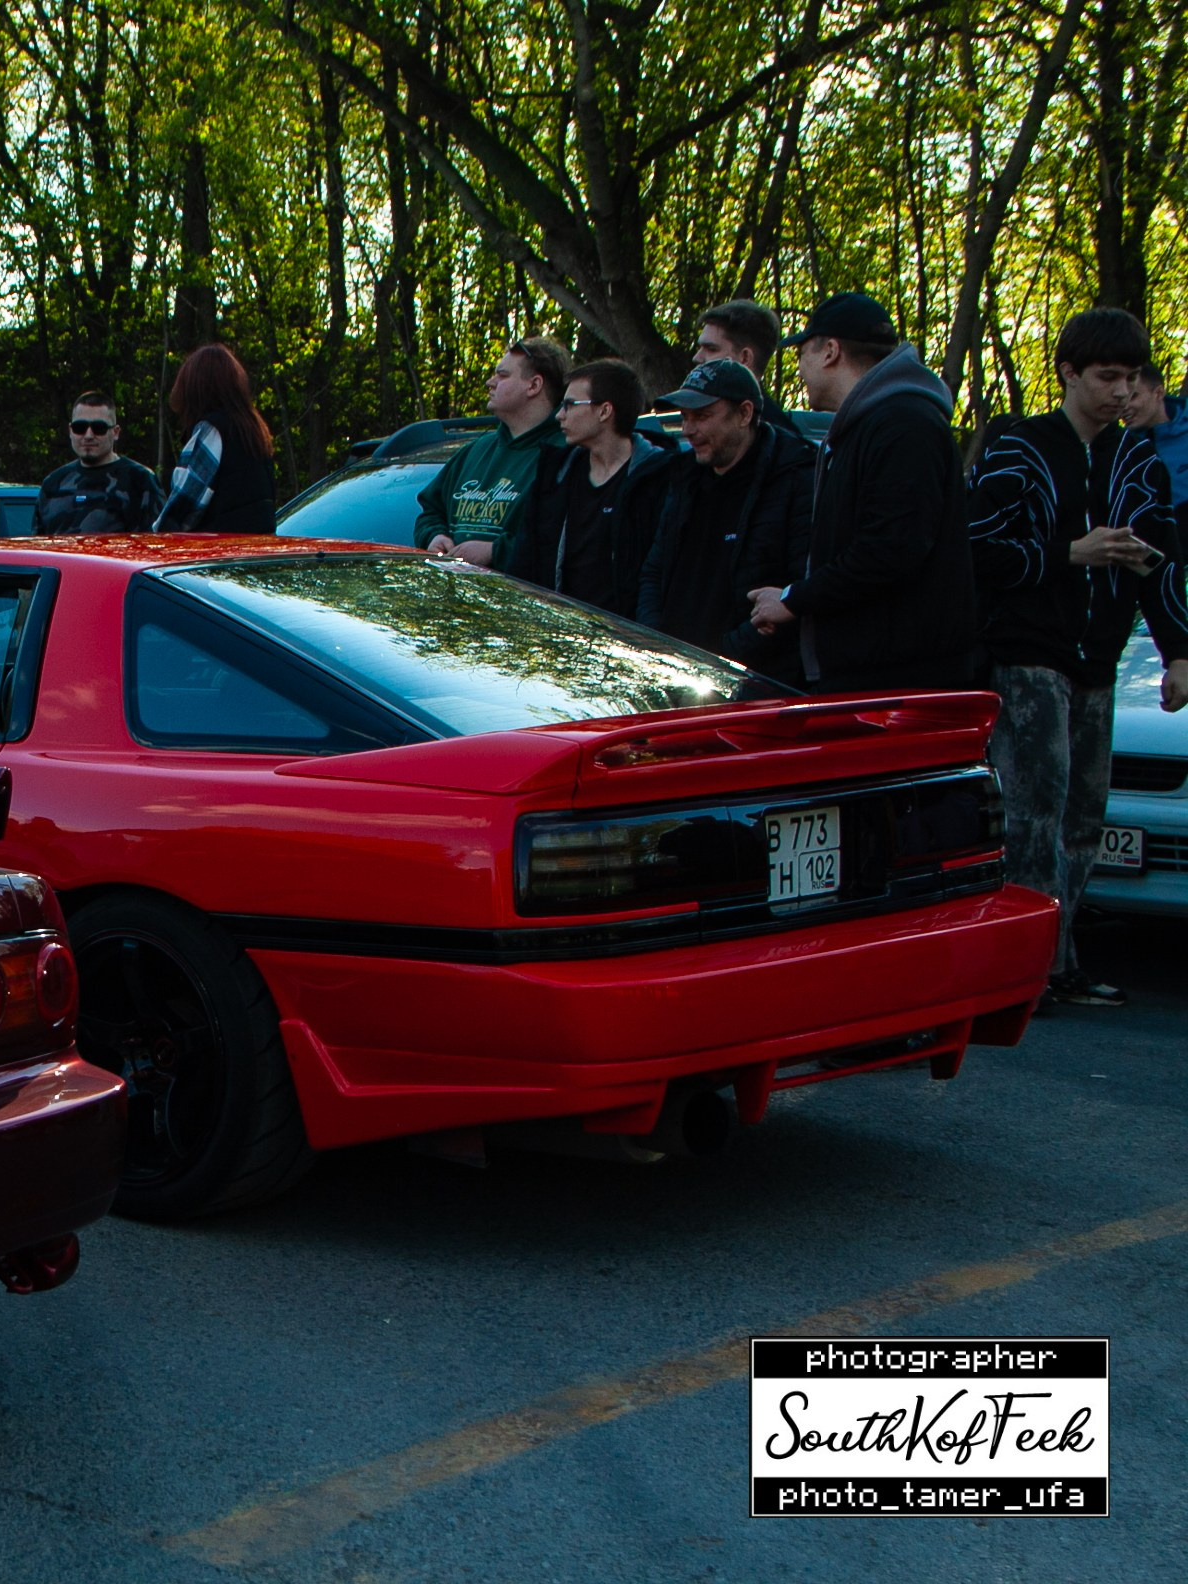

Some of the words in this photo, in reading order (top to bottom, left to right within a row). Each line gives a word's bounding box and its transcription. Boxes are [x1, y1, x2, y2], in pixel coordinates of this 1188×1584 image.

[453, 497, 509, 525] Hockey
[790, 813, 828, 850] 773
[1101, 829, 1134, 854] 02
[806, 854, 834, 882] 102
[1102, 853, 1123, 864] RUS
[812, 880, 826, 890] RUS
